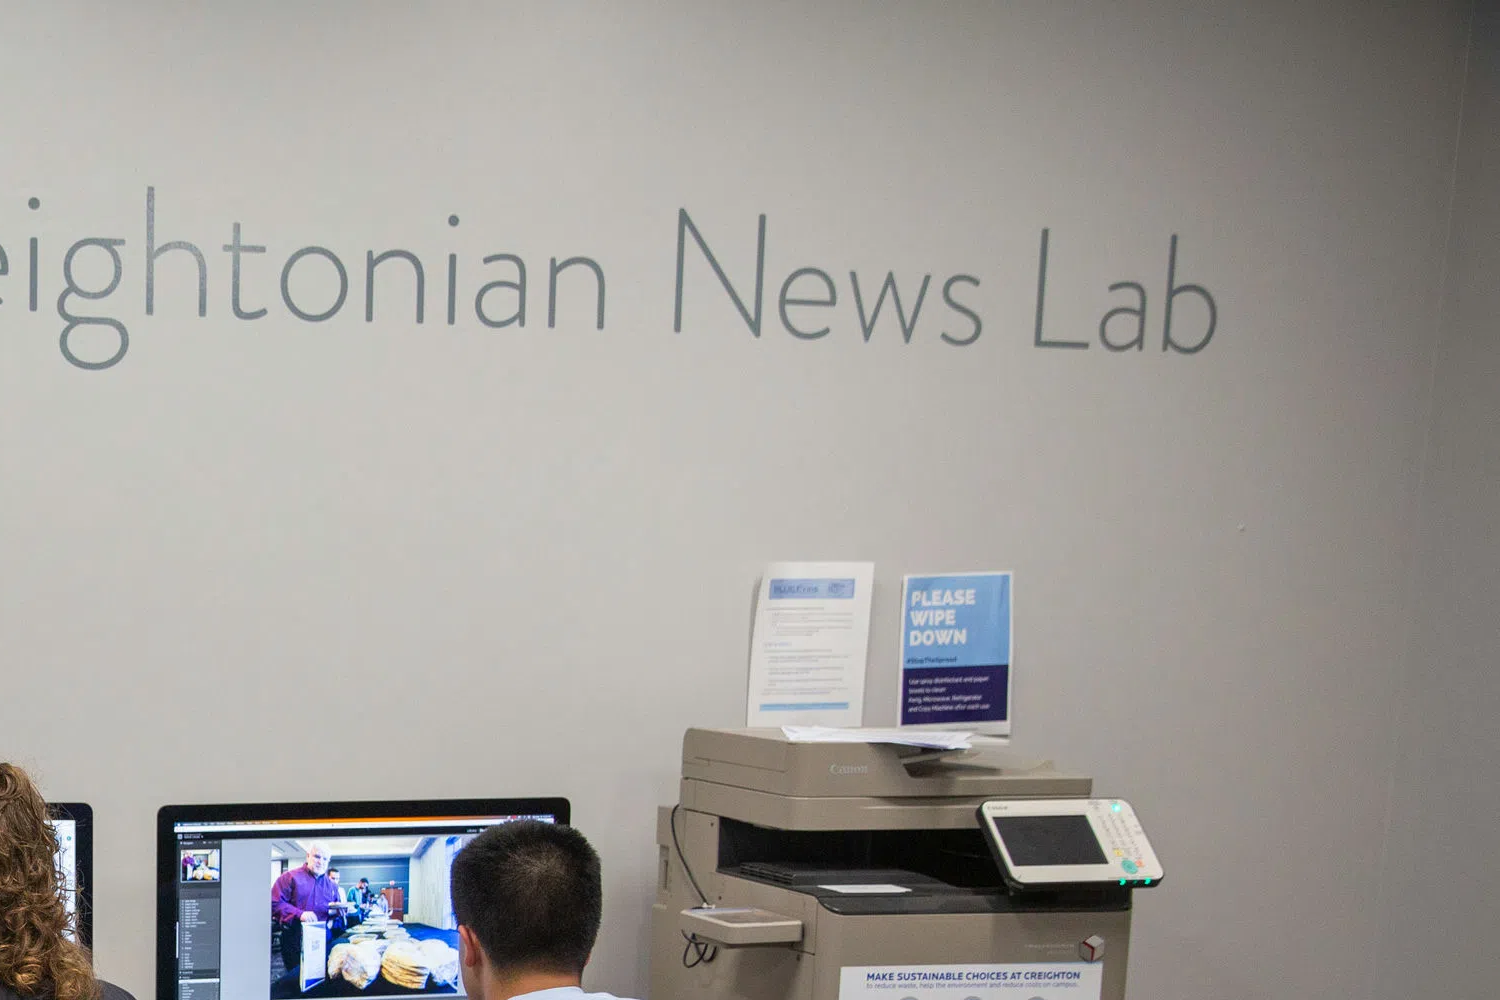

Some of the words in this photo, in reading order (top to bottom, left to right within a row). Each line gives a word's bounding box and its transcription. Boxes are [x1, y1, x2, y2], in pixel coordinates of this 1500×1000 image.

[674, 207, 983, 347] News
[1034, 228, 1218, 355] Lab
[911, 588, 976, 607] PLEASE
[910, 609, 957, 627] WIPE
[909, 628, 968, 647] DOWN
[829, 763, 868, 775] Canon
[866, 972, 895, 981] MAKE
[897, 971, 964, 981] SUSTAINABLE
[965, 971, 1008, 981] CHOICES
[1010, 971, 1022, 980] AT
[1023, 971, 1081, 980] CREIGHTON
[919, 982, 935, 990] help
